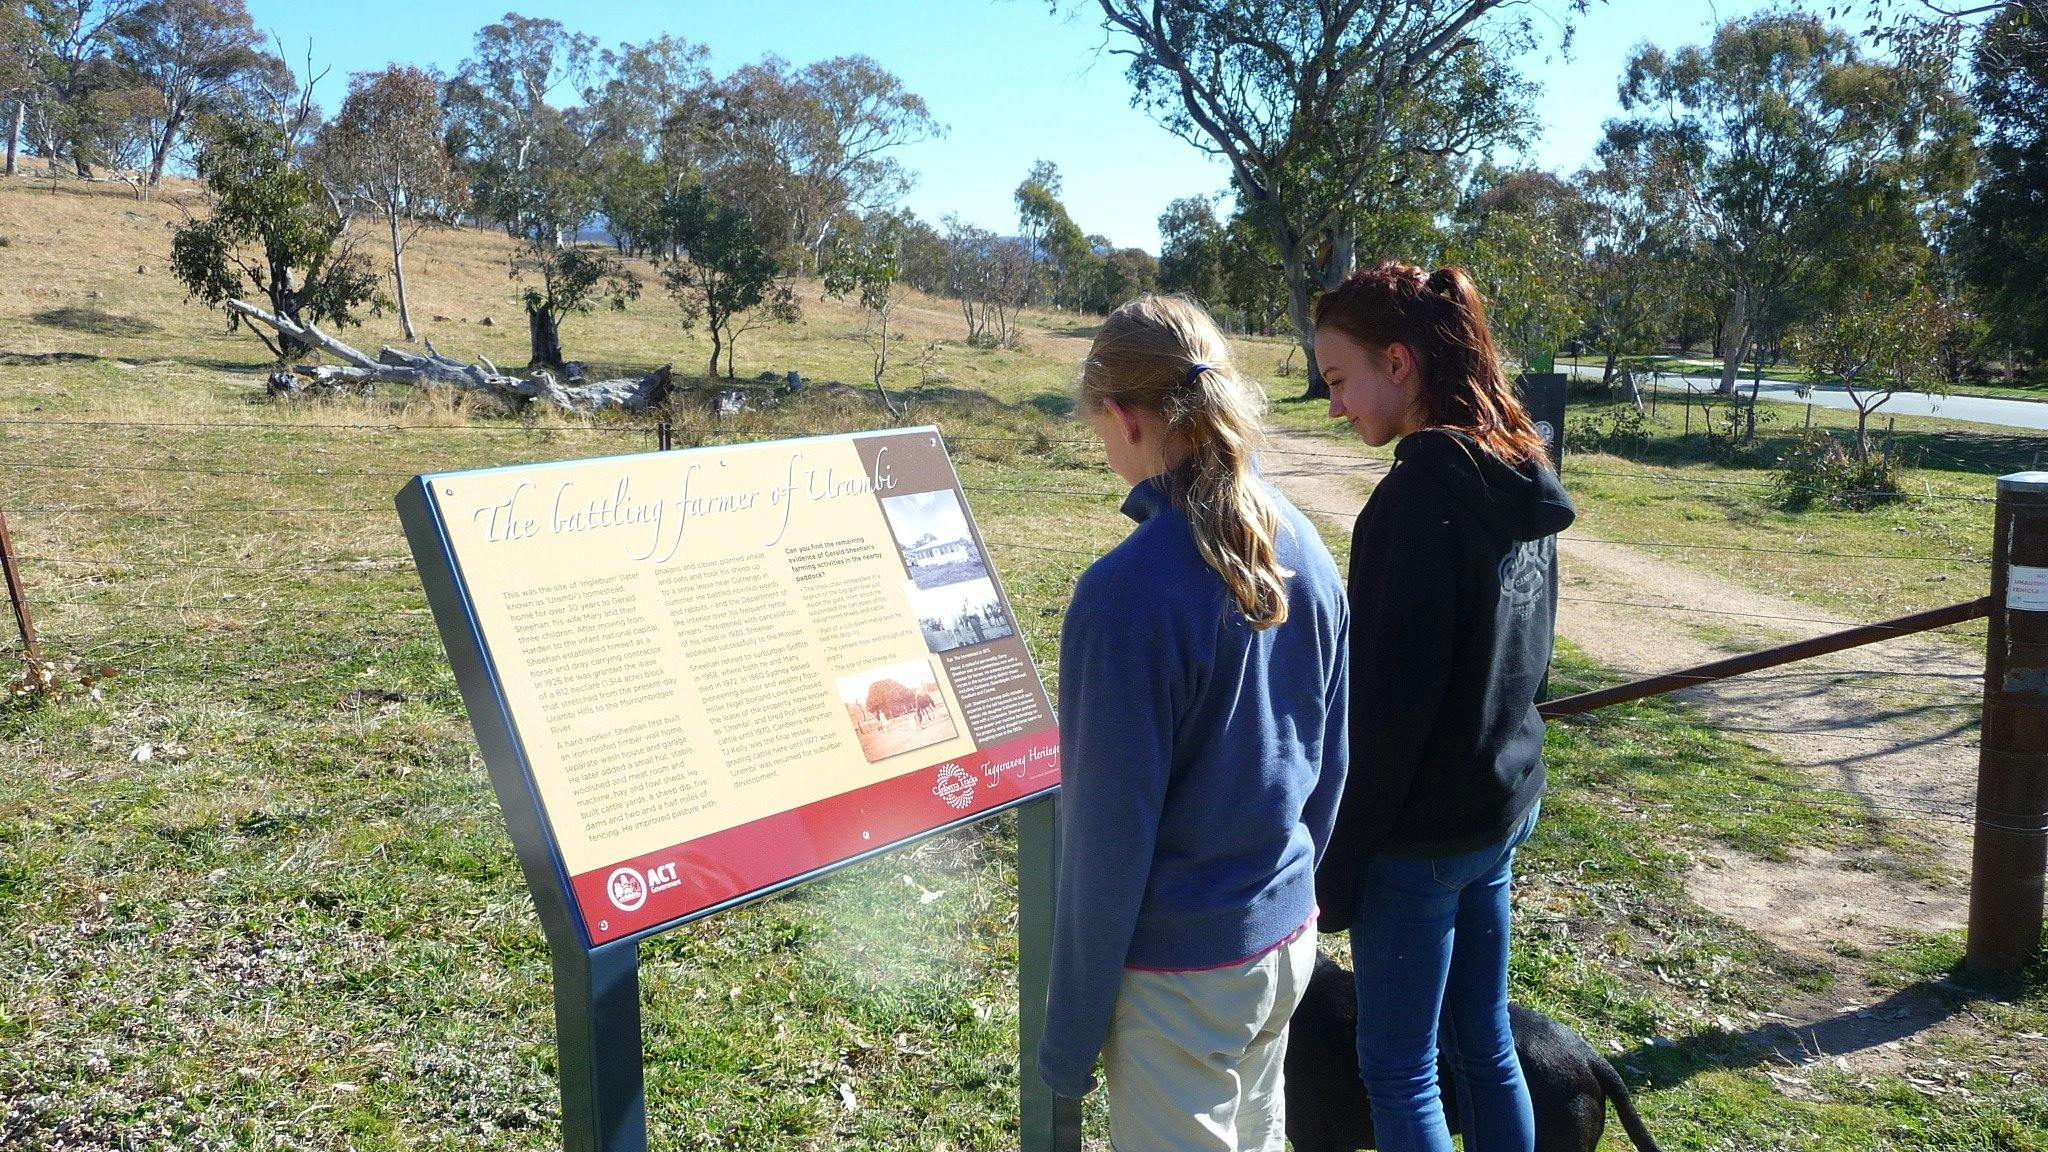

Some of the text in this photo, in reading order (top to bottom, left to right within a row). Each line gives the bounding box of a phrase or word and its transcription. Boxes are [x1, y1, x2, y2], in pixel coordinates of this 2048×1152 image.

[474, 446, 898, 563] The battling farmer of Urambi
[789, 555, 816, 563] evidence
[824, 548, 845, 557] Gerald
[845, 543, 874, 553] Sheehan's
[810, 542, 823, 550] find
[835, 537, 865, 546] remaining
[791, 564, 816, 572] farming
[817, 559, 844, 568] activities
[863, 551, 882, 560] nearby
[796, 571, 826, 583] paddock?
[980, 755, 1026, 788] Tuggeranong
[1028, 745, 1060, 767] Heritage
[647, 862, 677, 887] ACT
[650, 879, 681, 893] Government
